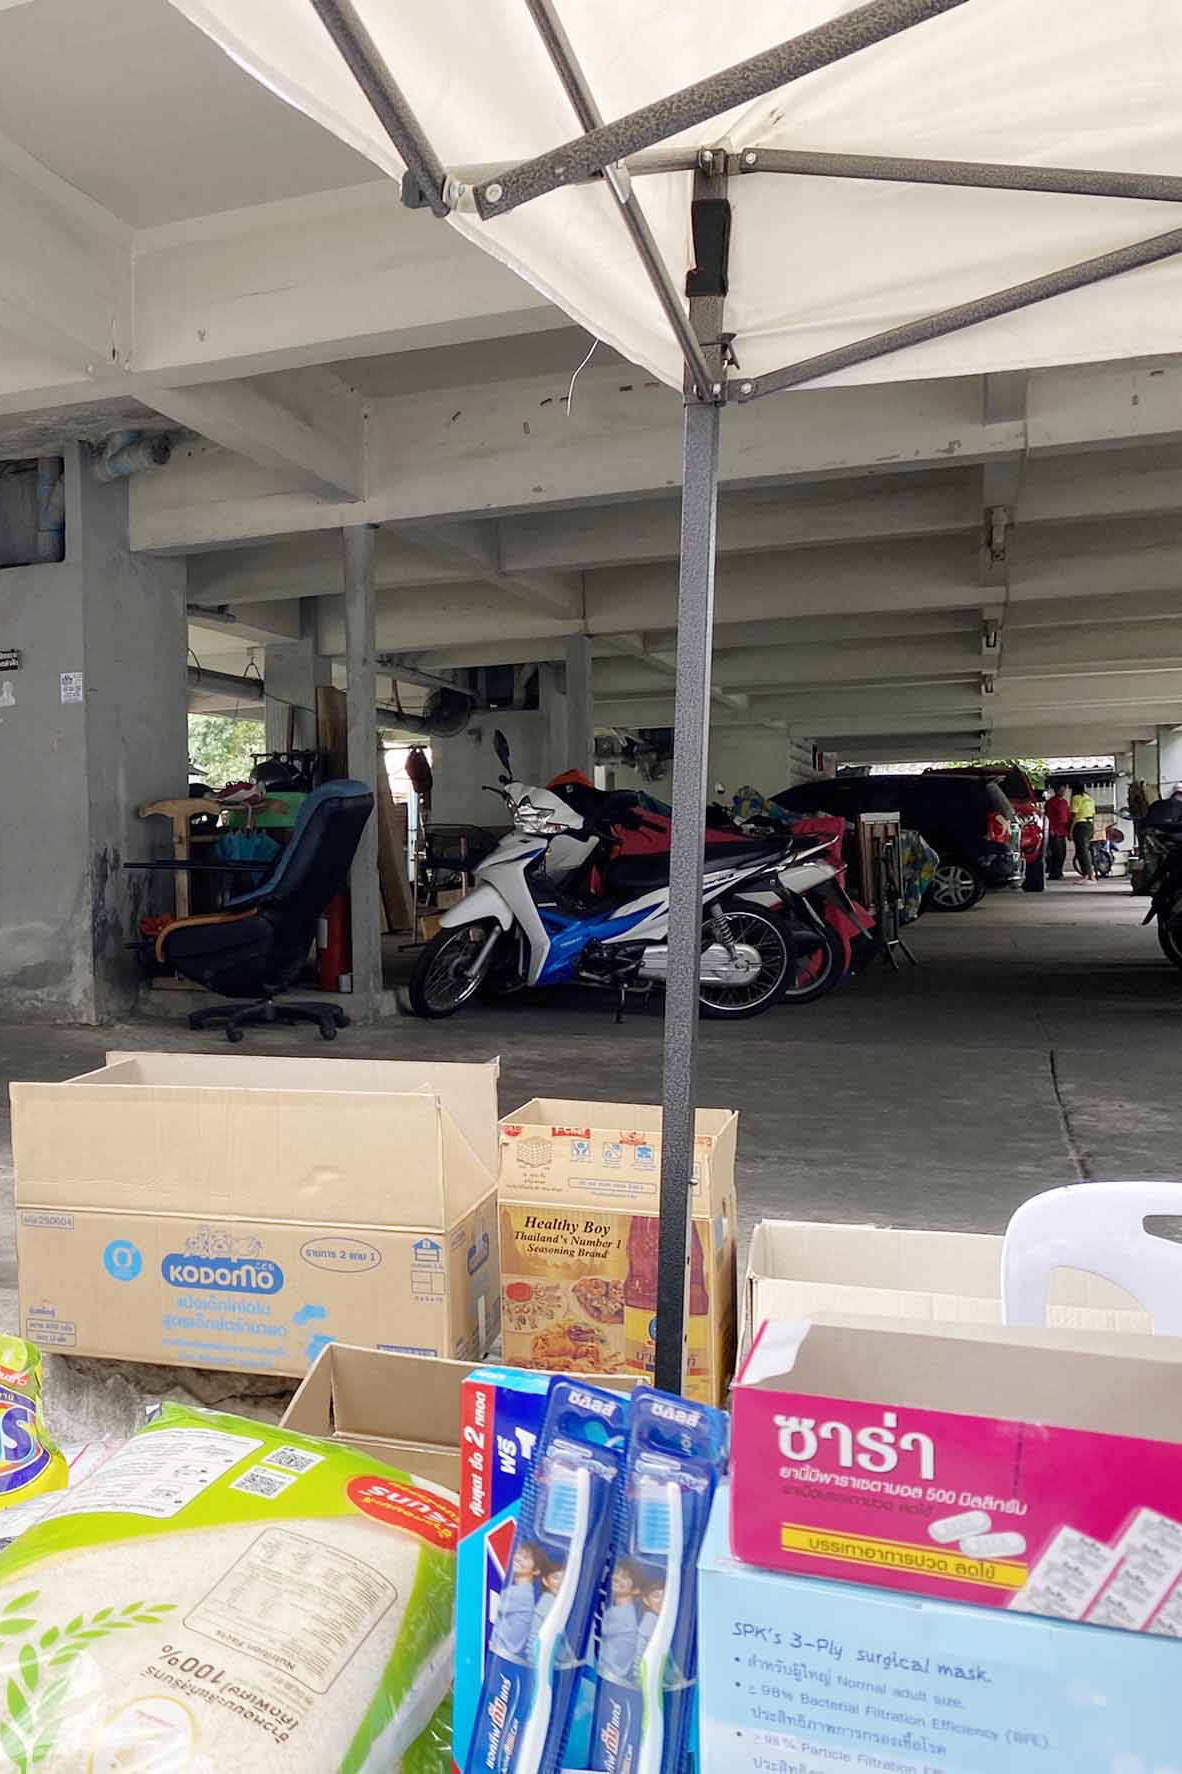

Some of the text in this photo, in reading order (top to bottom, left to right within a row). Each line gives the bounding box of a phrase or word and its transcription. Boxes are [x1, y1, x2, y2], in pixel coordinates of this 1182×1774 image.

[514, 1231, 622, 1250] Thailand's Number 1
[524, 1215, 611, 1236] Healthy Boy
[339, 1249, 347, 1260] 2
[527, 1243, 609, 1259] Seasoning Brand
[169, 1263, 275, 1290] KODOMO
[464, 1391, 487, 1518] คุ้มสุด! ซื้อ 2 หลอด
[497, 1435, 517, 1474] ฟรี
[514, 1426, 538, 1460] 1
[774, 1412, 936, 1481] ซาร่า
[779, 1465, 1028, 1517] ยานี้มีพาราเซตามอล 500 มิลลิกรัม
[809, 1536, 996, 1581] บรรเทาอาการปวด ลดไข้
[157, 1643, 226, 1686] 100%
[732, 1621, 993, 1683] SPK's 3-Ply surgical mask.
[748, 1653, 832, 1687] สำหรับผู้ใหญ่
[837, 1675, 887, 1695] Normal
[892, 1687, 927, 1703] adult
[760, 1685, 794, 1701] 98%
[801, 1692, 859, 1714] Bacterial
[866, 1706, 926, 1728] Filtration
[932, 1718, 999, 1742] Efficiency
[801, 1742, 852, 1763] Particle
[857, 1753, 917, 1774] Filtration
